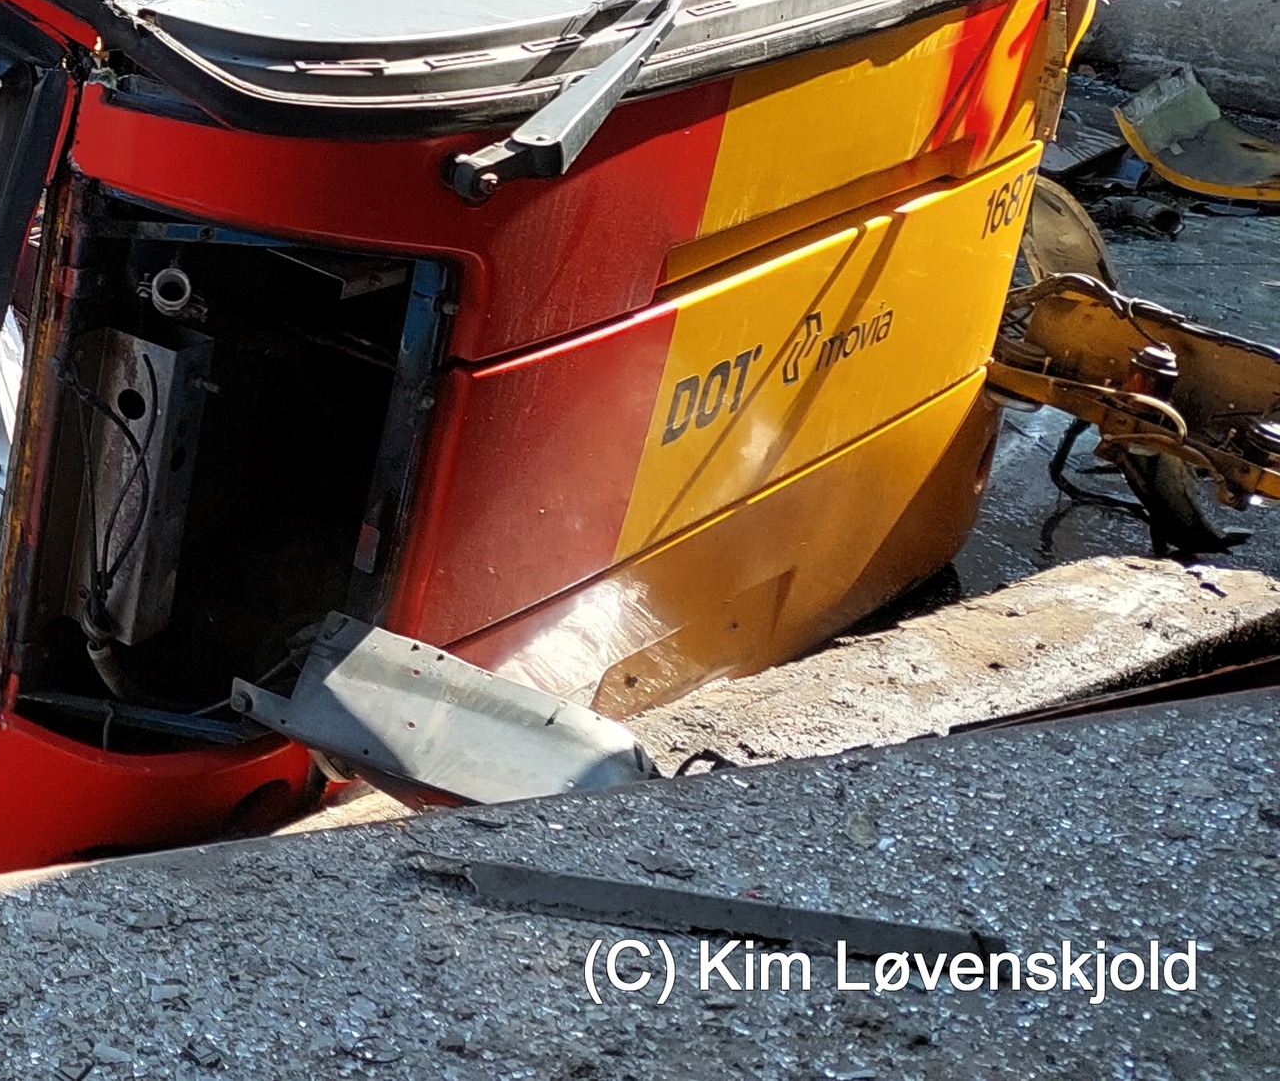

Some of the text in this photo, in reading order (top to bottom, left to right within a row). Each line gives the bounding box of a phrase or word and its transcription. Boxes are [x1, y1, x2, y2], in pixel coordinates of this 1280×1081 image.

[981, 166, 1038, 240] 1687
[661, 303, 894, 447] DOT movia
